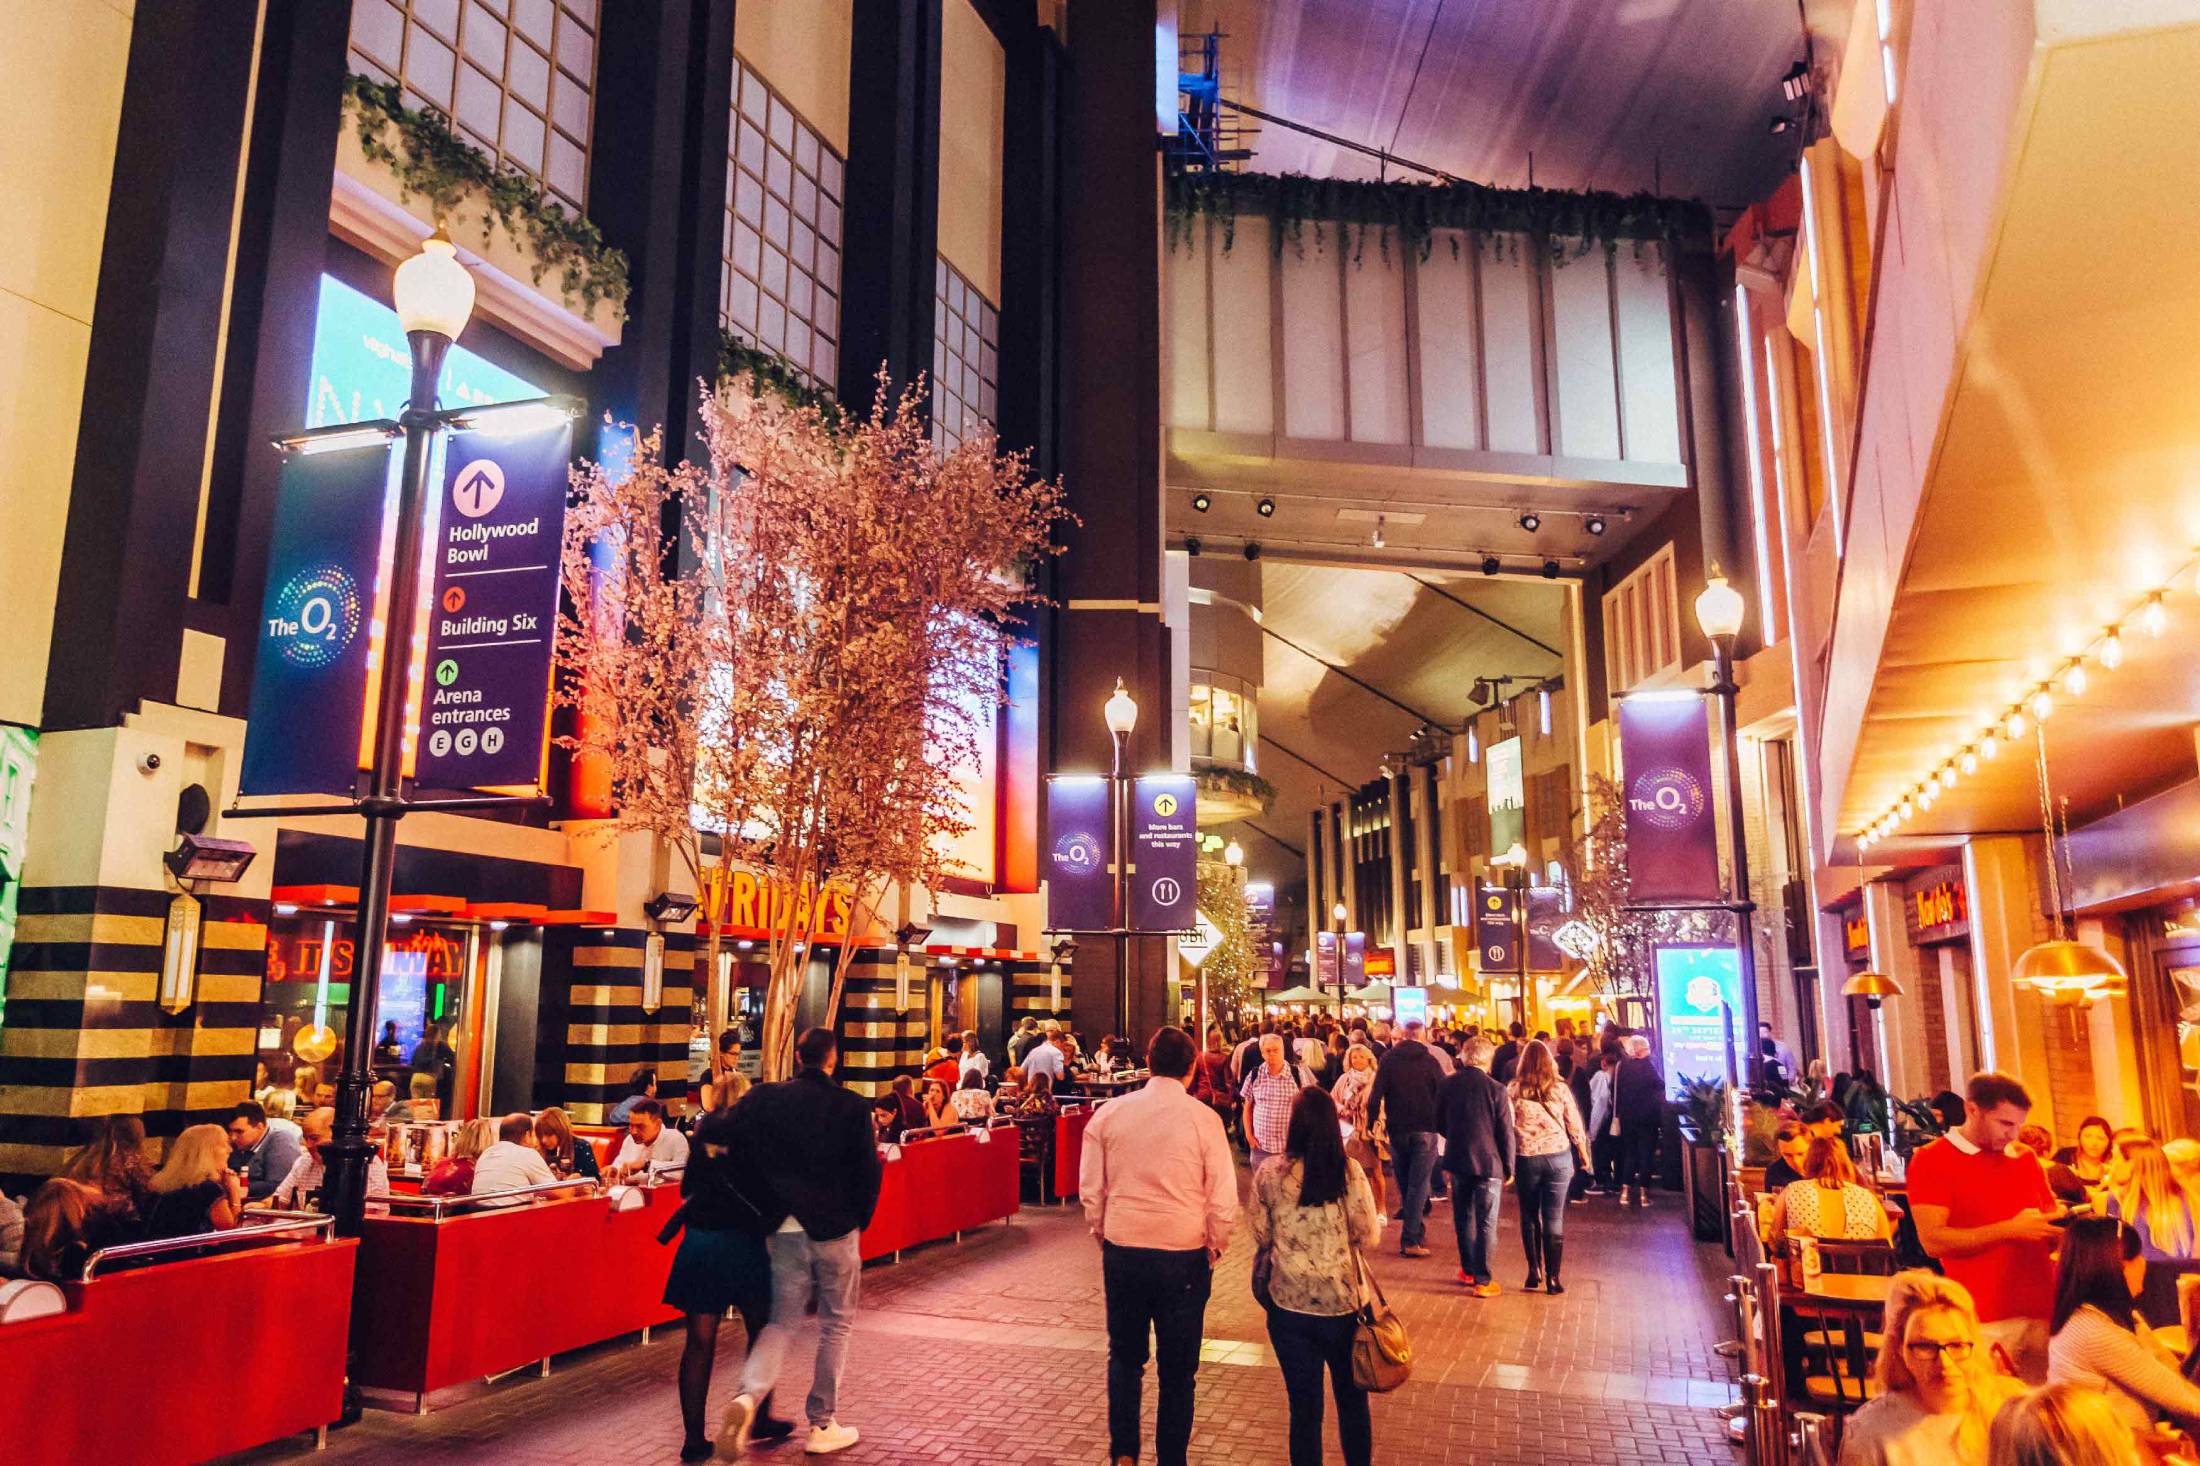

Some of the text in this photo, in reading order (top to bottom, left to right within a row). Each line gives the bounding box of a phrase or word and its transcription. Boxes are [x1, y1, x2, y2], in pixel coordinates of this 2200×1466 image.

[448, 516, 540, 544] Hollywood
[446, 543, 489, 565] Bowl
[268, 617, 299, 637] The
[440, 612, 538, 636] Building Six
[432, 688, 483, 705] Arena
[431, 707, 512, 725] entrances
[436, 734, 498, 750] E G H
[1628, 798, 1656, 811] The
[1052, 852, 1069, 862] The
